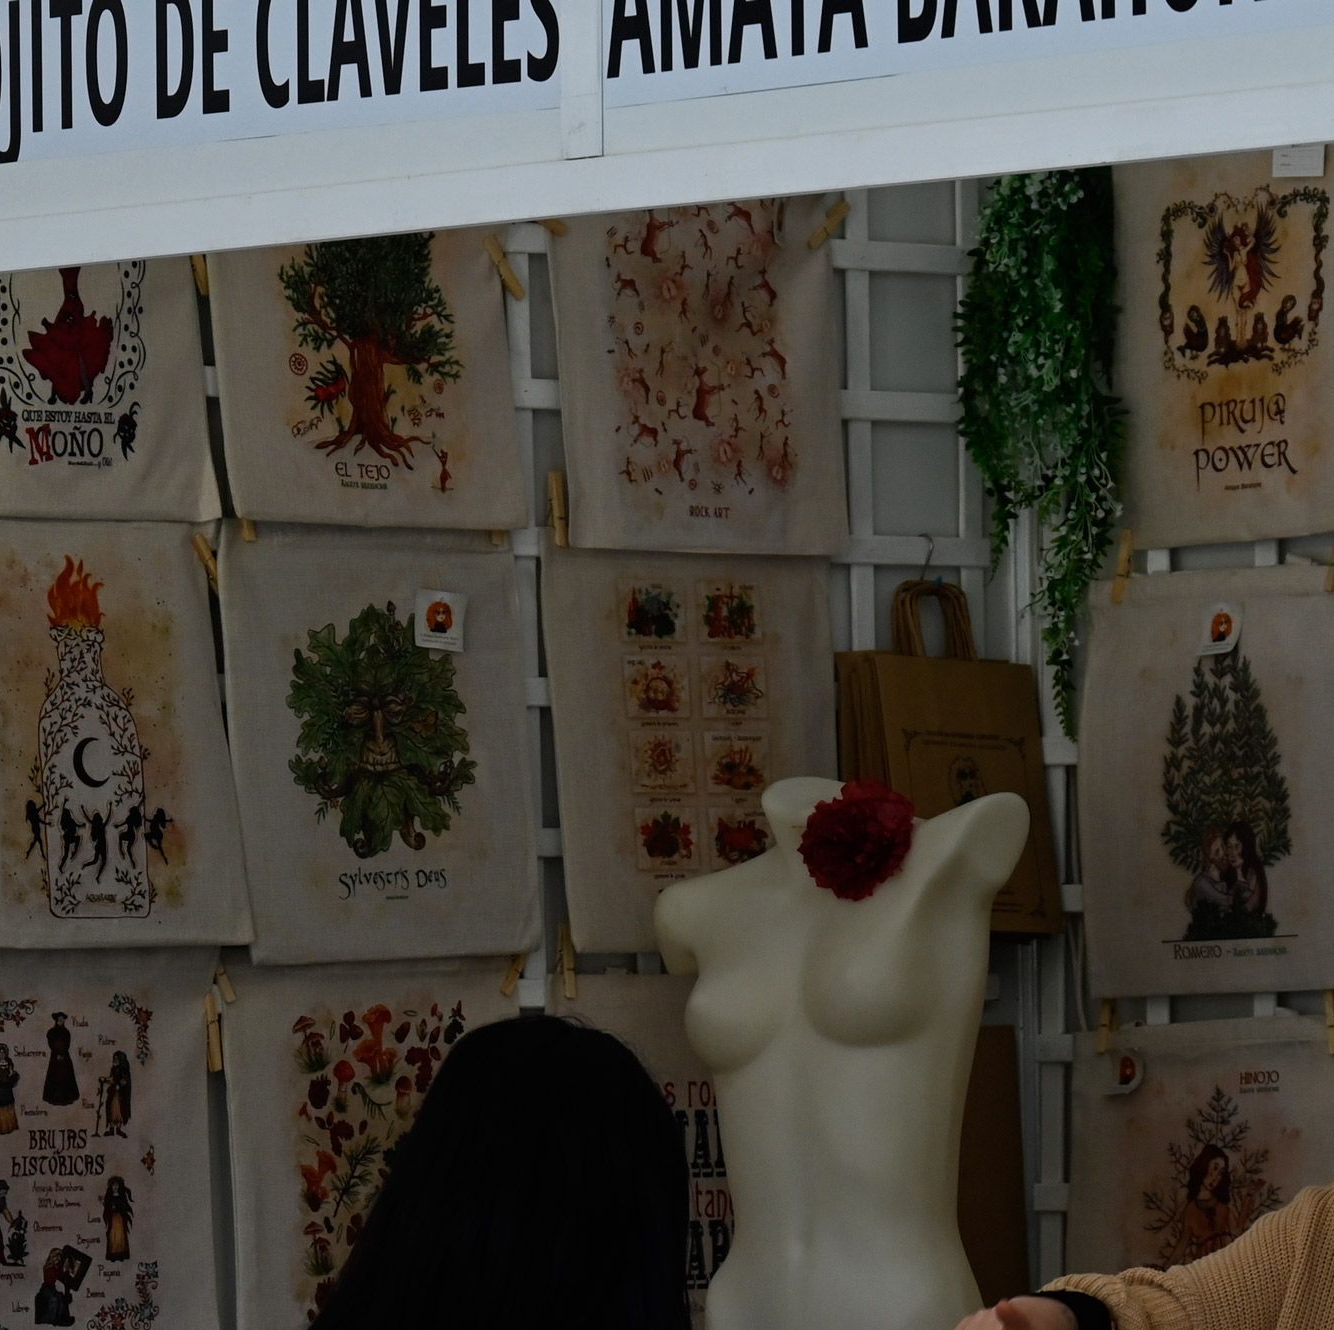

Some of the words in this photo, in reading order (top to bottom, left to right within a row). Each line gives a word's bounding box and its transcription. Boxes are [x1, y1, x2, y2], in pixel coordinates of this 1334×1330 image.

[156, 0, 230, 119] DE
[255, 0, 560, 109] CLAVELES
[22, 409, 43, 422] QUE
[45, 410, 73, 423] ESTOY
[74, 411, 102, 424] HASTA
[104, 412, 115, 424] EL
[25, 423, 104, 466] MOÑO
[335, 461, 352, 477] EL
[357, 463, 390, 481] TEJO
[1193, 439, 1298, 492] POWER
[415, 868, 447, 889] Deus
[1174, 944, 1222, 960] ROMERO
[1240, 1070, 1279, 1085] HINOJO
[28, 1129, 87, 1154] BRUJAS
